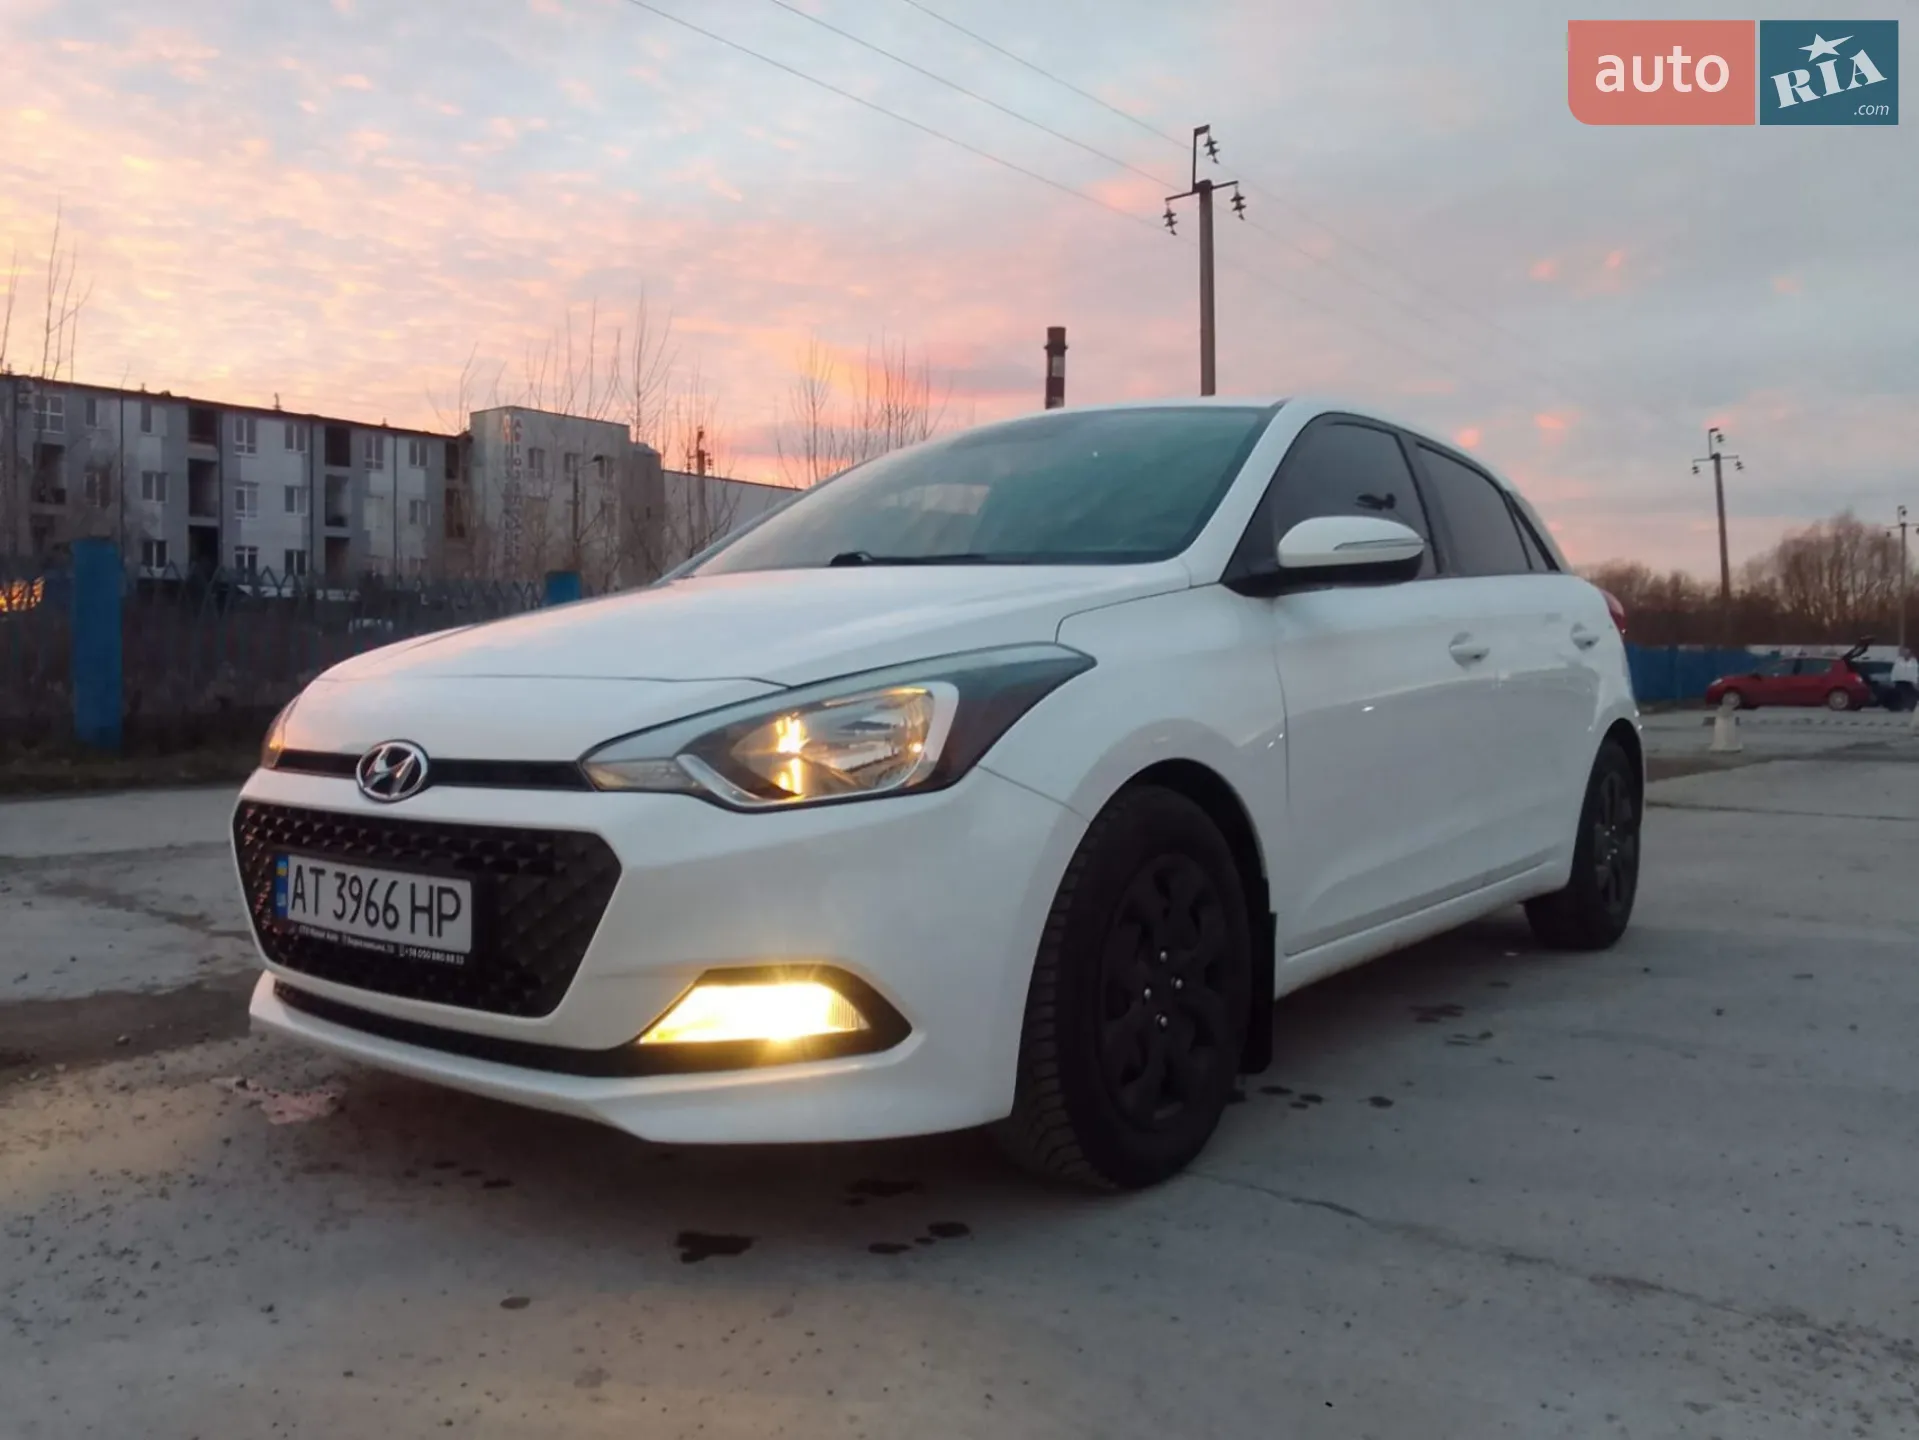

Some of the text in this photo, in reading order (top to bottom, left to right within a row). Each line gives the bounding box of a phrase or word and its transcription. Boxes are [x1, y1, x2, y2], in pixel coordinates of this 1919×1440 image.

[291, 864, 462, 939] AT 3966 HP
